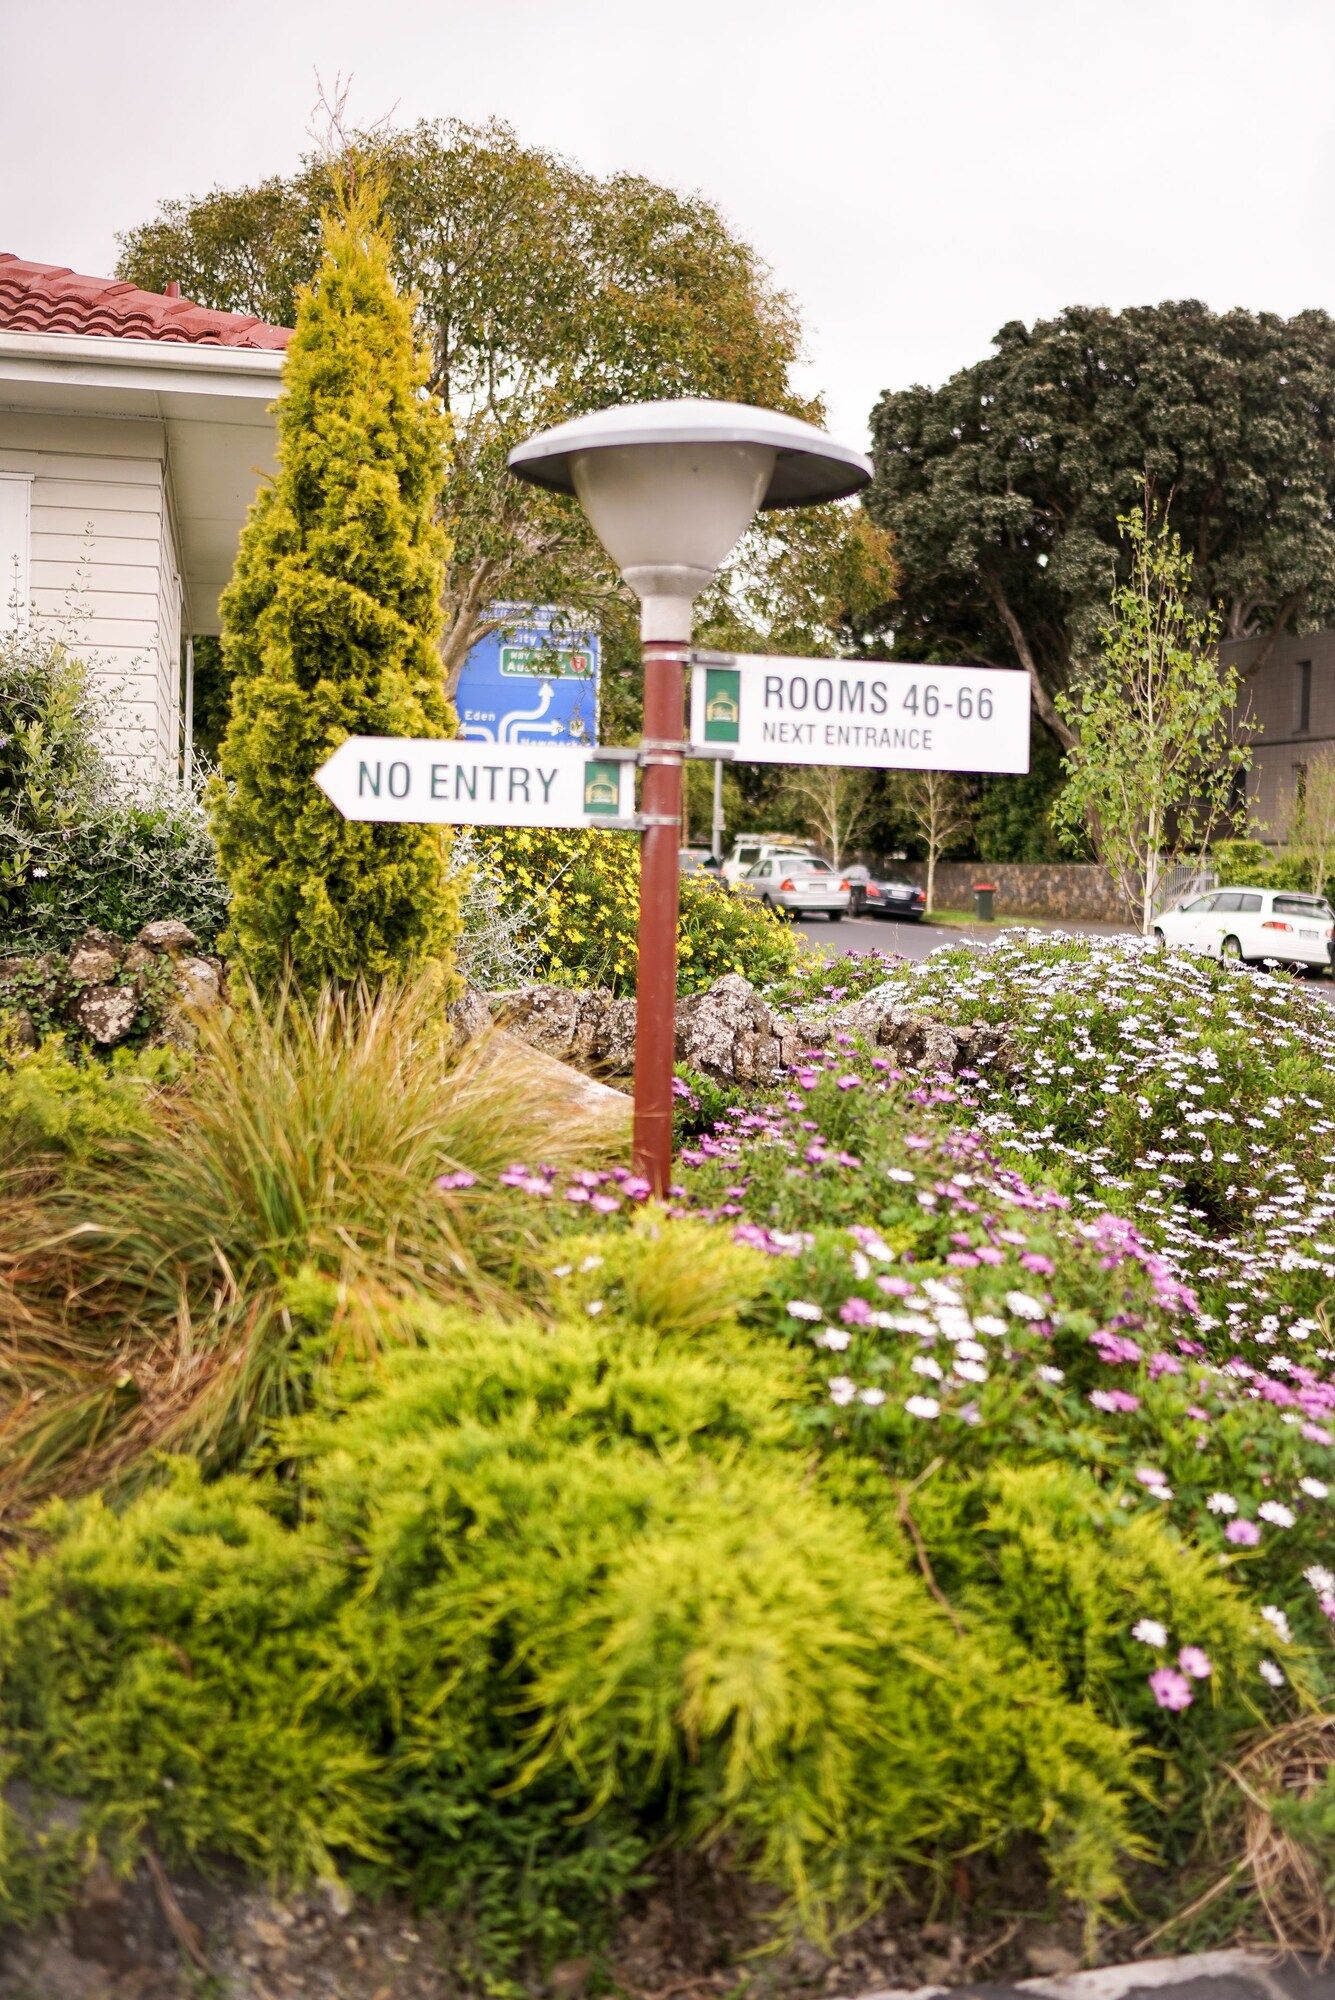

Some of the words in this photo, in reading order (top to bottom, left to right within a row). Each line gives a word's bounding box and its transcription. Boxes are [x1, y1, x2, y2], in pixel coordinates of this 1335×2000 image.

[464, 710, 496, 721] Eden
[764, 675, 888, 715] ROOMS
[903, 684, 993, 721] 46-66
[762, 722, 816, 744] NEXT
[825, 725, 933, 750] ENTRANCE
[358, 761, 411, 798] NO
[430, 763, 558, 803] ENTRY
